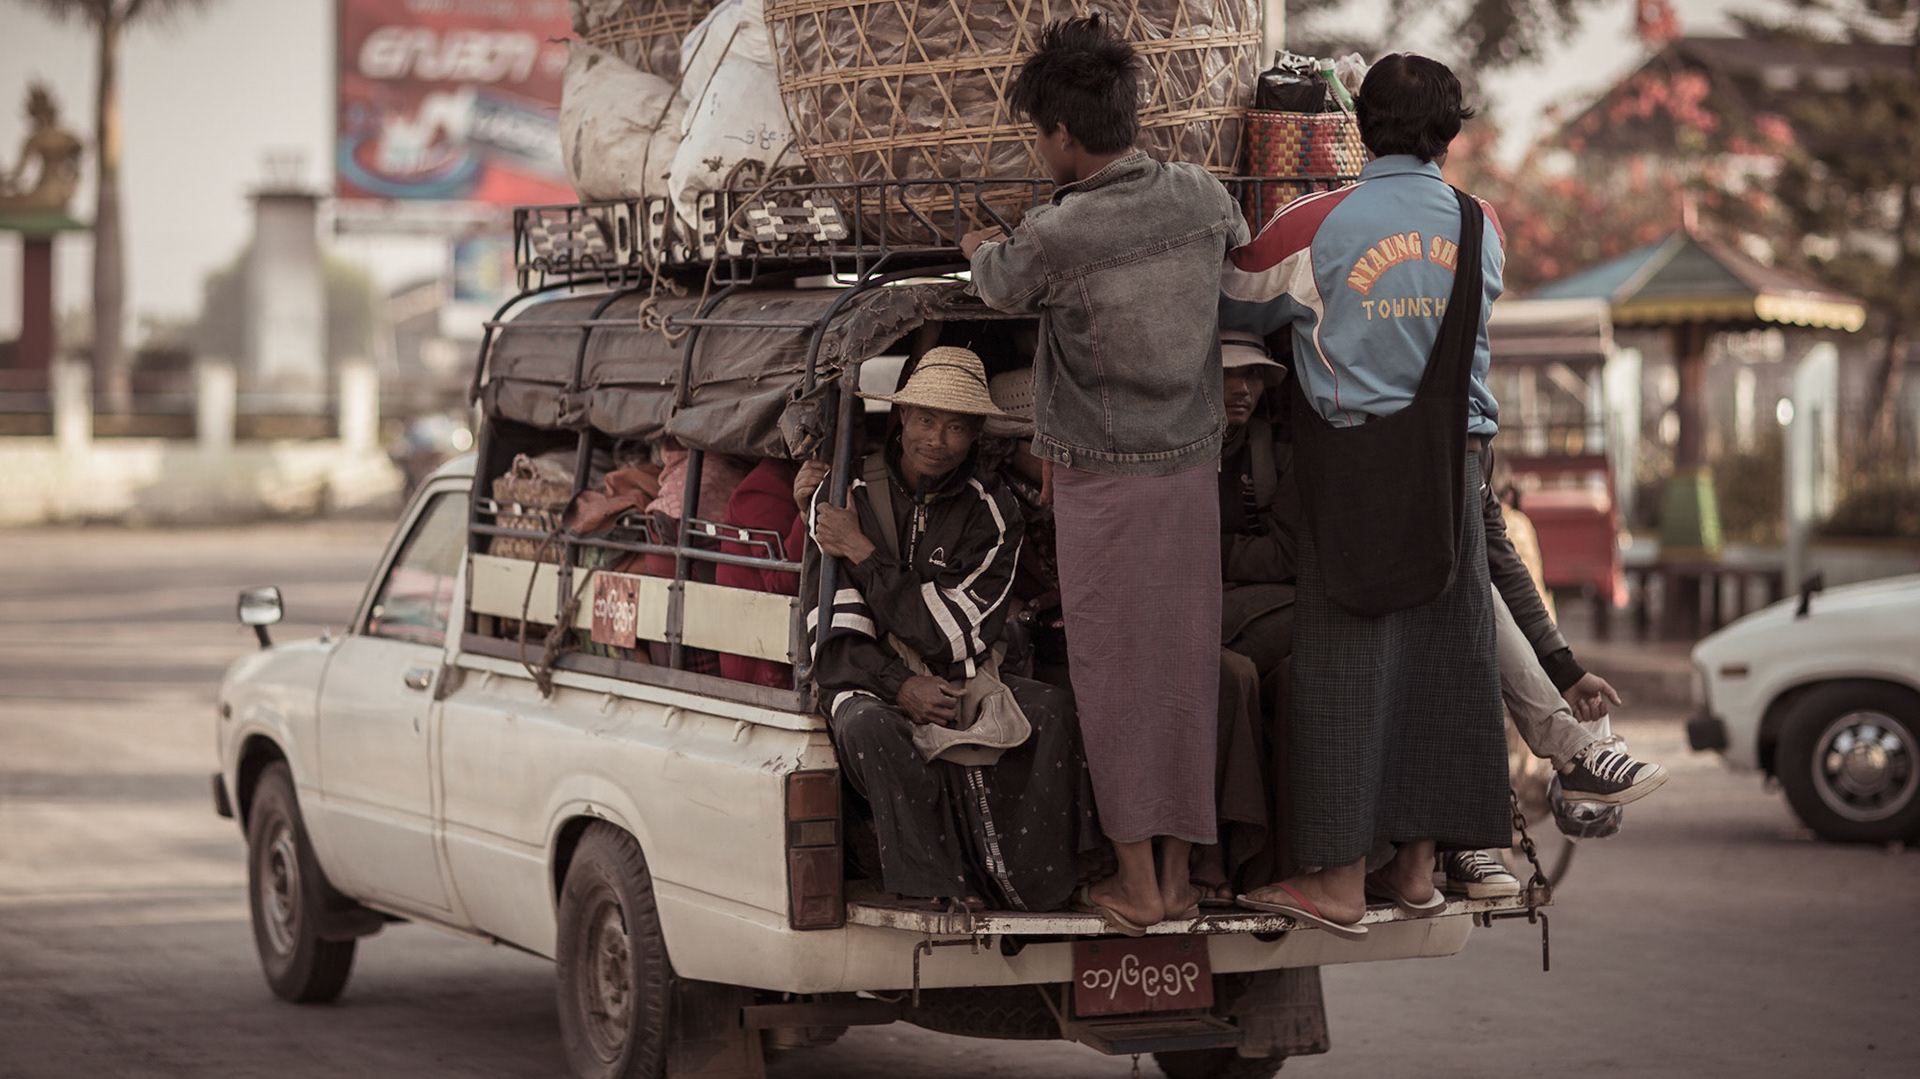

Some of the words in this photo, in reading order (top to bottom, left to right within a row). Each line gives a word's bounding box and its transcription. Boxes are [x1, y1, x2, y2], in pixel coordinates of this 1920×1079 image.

[1346, 230, 1424, 297] NYAUNG
[1428, 234, 1459, 275] SH
[1361, 297, 1447, 321] TOWNSH
[1082, 953, 1200, 1000] ဘ/၆၉၅၃
